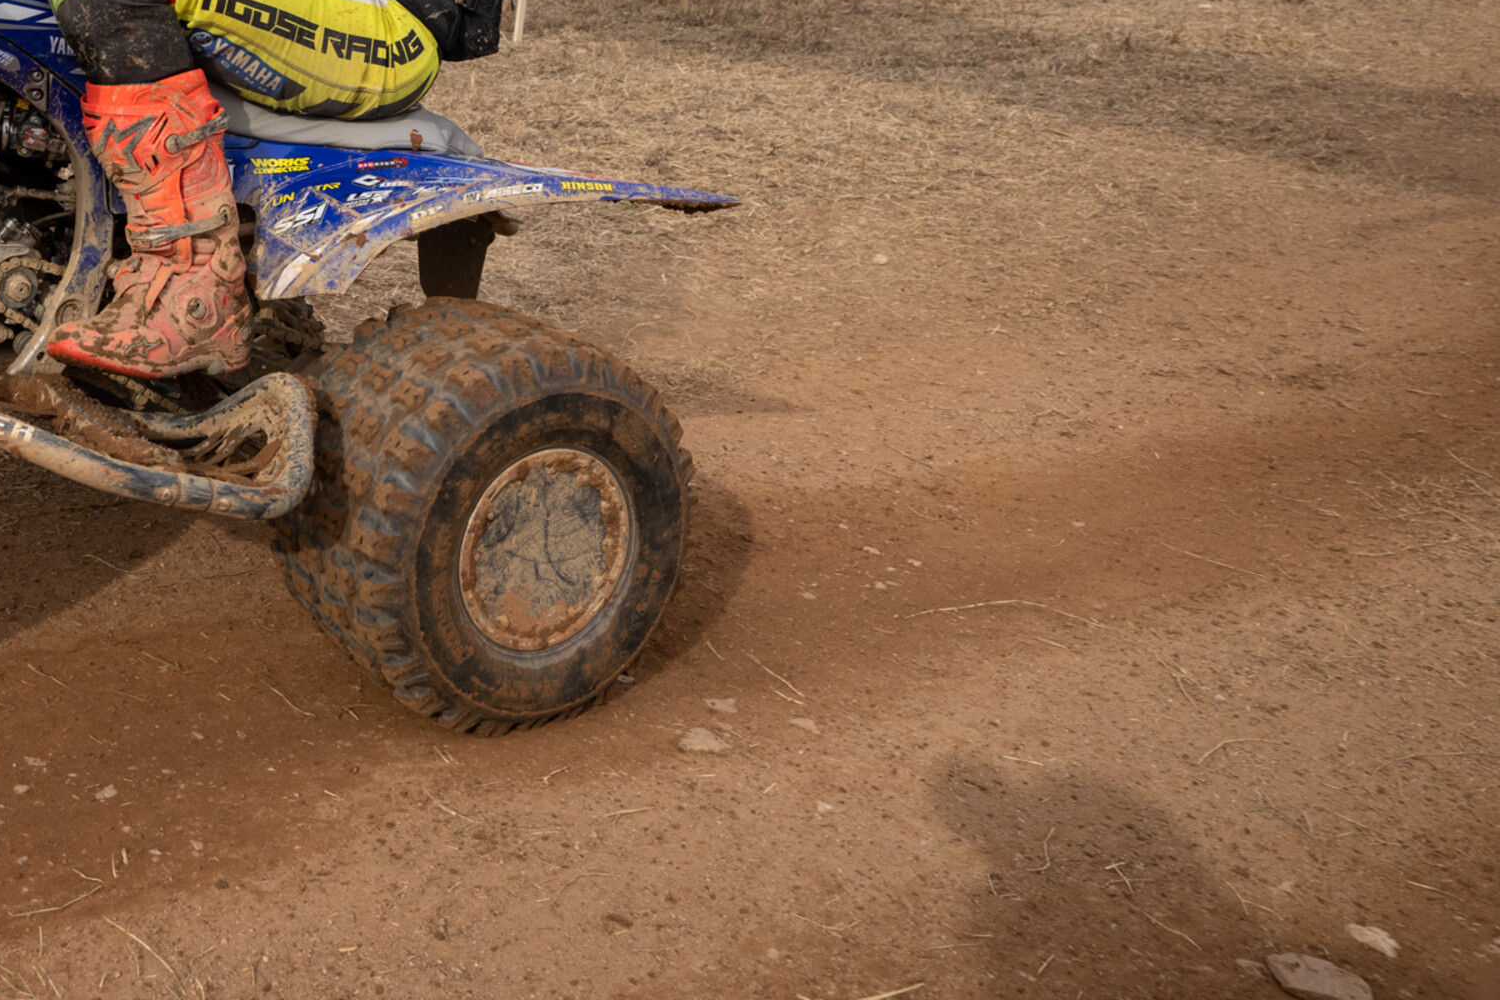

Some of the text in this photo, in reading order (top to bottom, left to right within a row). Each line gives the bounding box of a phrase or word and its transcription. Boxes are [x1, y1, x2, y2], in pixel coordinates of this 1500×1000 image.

[212, 37, 282, 91] YAMAHA
[250, 157, 311, 168] WORKS
[253, 165, 310, 175] CONNECTION
[561, 181, 613, 192] HINSON
[261, 182, 341, 211] UNTAR
